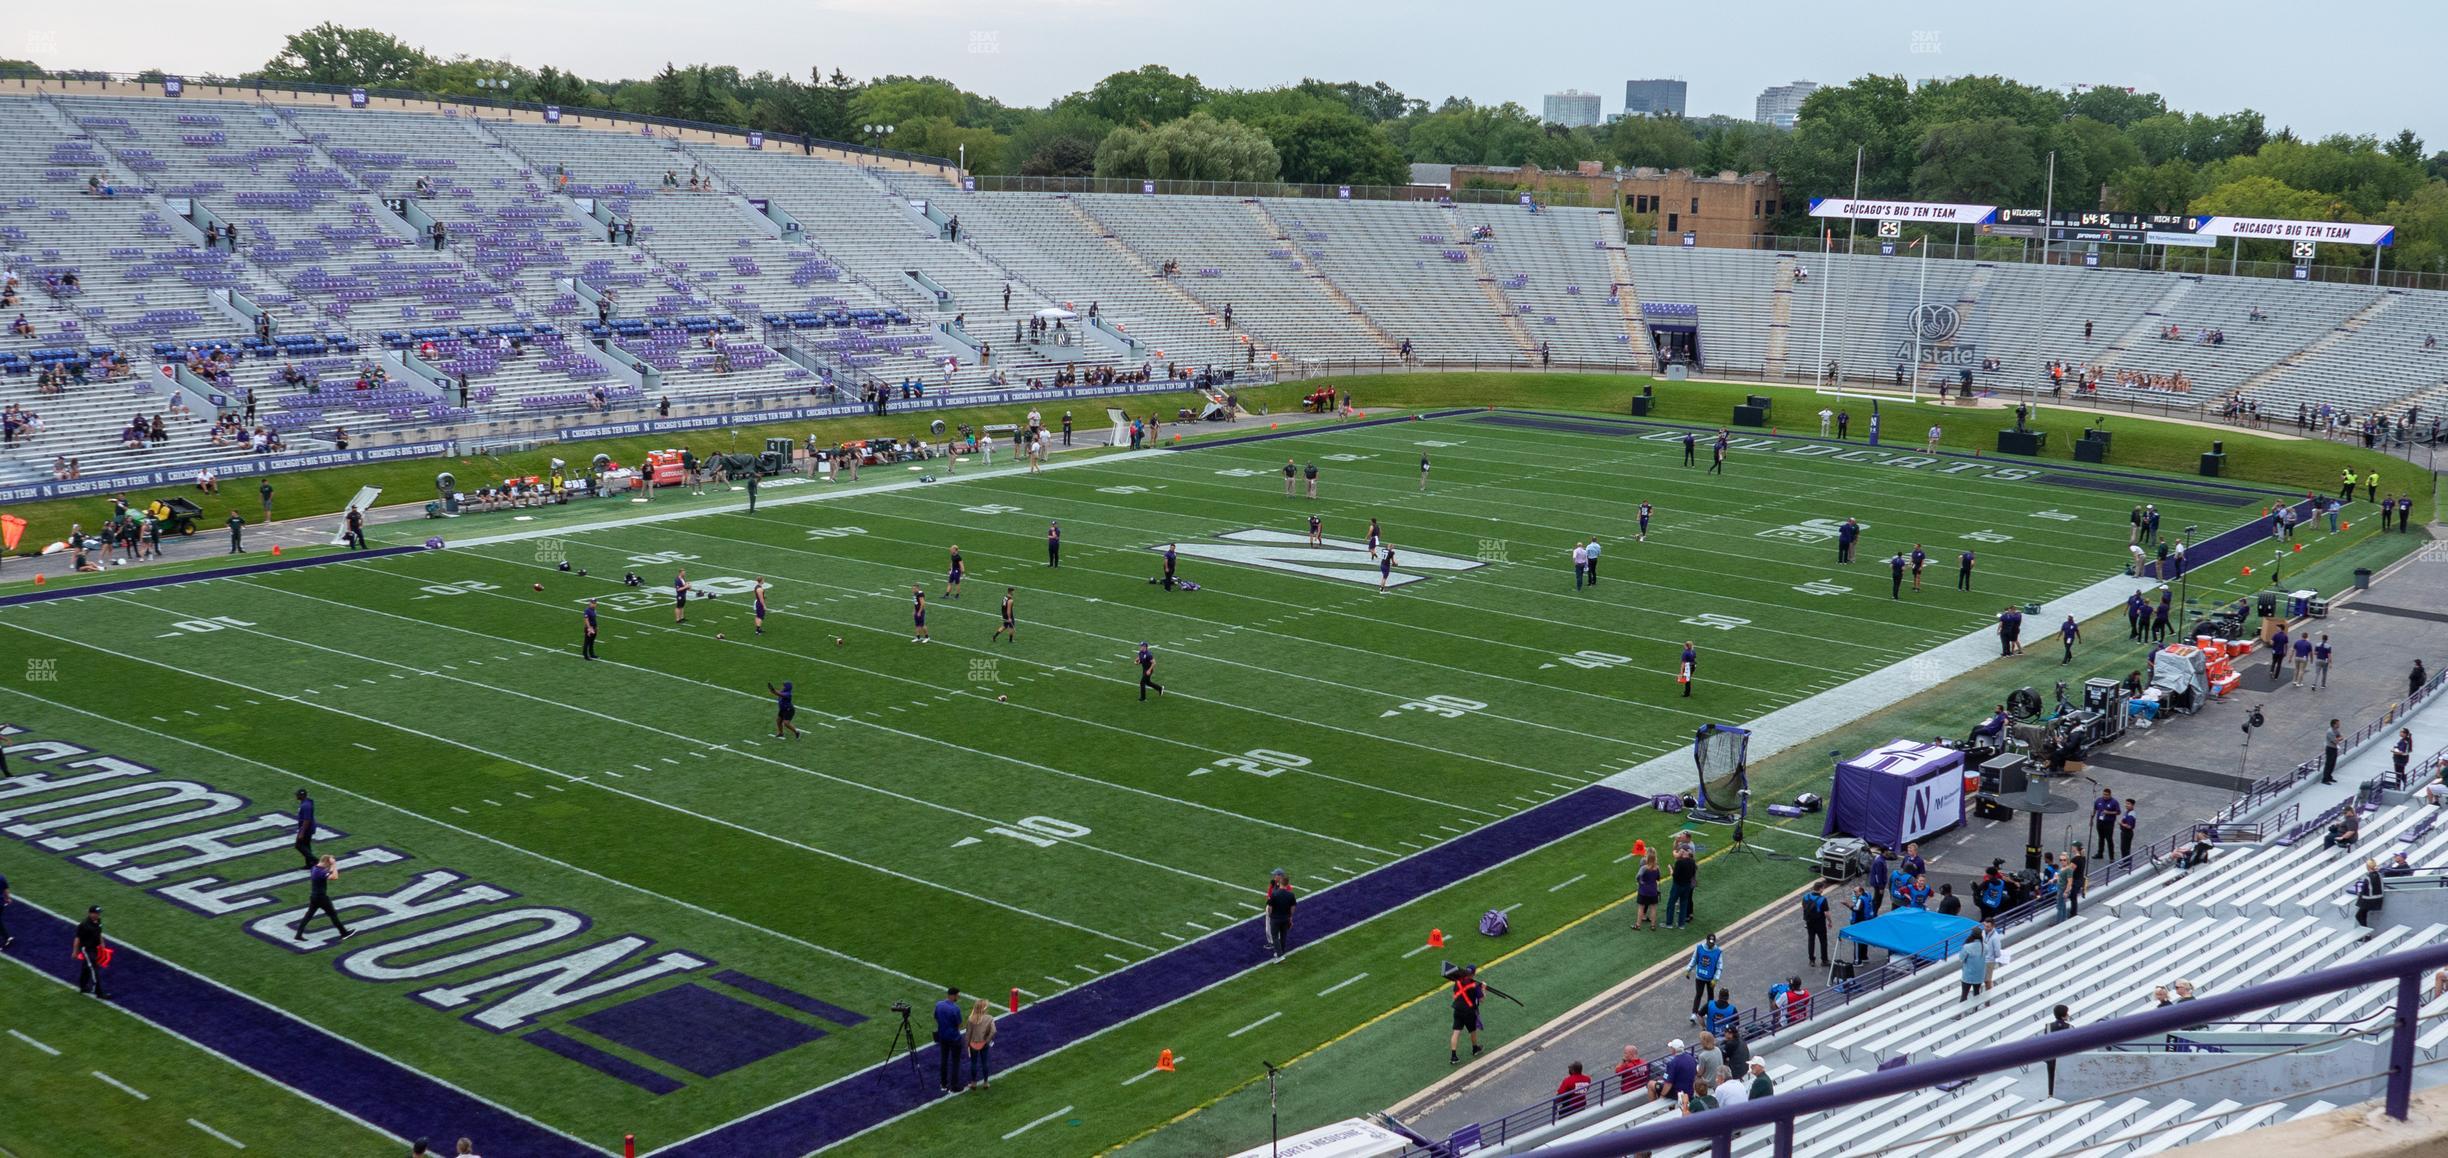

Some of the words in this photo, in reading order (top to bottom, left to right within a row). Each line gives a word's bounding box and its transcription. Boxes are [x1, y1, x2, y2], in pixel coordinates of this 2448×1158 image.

[548, 111, 558, 120] 110
[752, 137, 761, 145] 111
[1340, 190, 1349, 198] 114
[1843, 204, 1891, 216] CHICAGO'S
[1894, 206, 1909, 217] BIG
[1913, 207, 1929, 217] TEN
[1933, 208, 1956, 218] TEAM
[2003, 210, 2011, 221] 0
[2012, 209, 2041, 217] WILDCATS
[2171, 216, 2181, 224] ST
[2188, 218, 2197, 230] 0
[1881, 222, 1898, 235] 25
[2232, 222, 2282, 235] CHICAGO'S
[2285, 226, 2301, 236] BIG
[2305, 227, 2322, 237] TEN
[2326, 228, 2351, 239] TEAM
[1882, 246, 1893, 254] 117
[2295, 243, 2313, 256] 25
[1058, 334, 1065, 345] N
[1896, 341, 1973, 364] Allstate
[561, 430, 568, 439] N
[572, 427, 601, 438] CHICAGO'S
[602, 426, 612, 435] BIG
[612, 425, 624, 434] TEN
[624, 424, 640, 433] TEAM
[644, 422, 650, 431] N
[654, 419, 681, 430] CHICAGO'S
[682, 419, 691, 428] BIG
[692, 418, 703, 427] TEN
[703, 417, 718, 426] TEAM
[722, 416, 728, 425] N
[759, 413, 768, 421] BIG
[768, 412, 778, 420] TEN
[779, 411, 793, 420] TEAM
[797, 410, 803, 418] N
[806, 407, 832, 417] CHICAGO'S
[832, 406, 841, 415] BIG
[841, 405, 851, 414] TEN
[851, 405, 865, 413] TEAM
[901, 400, 910, 409] BIG
[911, 400, 920, 408] TEN
[920, 399, 934, 408] TEAM
[937, 398, 942, 406] N
[945, 396, 970, 405] CHICAGO'S
[1870, 417, 1877, 426] N
[15, 488, 37, 499] TEAM
[43, 485, 53, 497] N
[58, 481, 98, 494] CHICAGO'S
[98, 479, 111, 489] BIG
[112, 478, 128, 488] TEN
[128, 475, 150, 485] TEAM
[155, 472, 163, 483] N
[168, 469, 202, 481] CHICAGO'
[219, 466, 233, 475] TEN
[234, 463, 254, 473] TEAM
[259, 461, 266, 472] N
[271, 458, 306, 470] CHICAGO'S
[306, 456, 318, 466] BIG
[318, 454, 333, 464] TEN
[333, 452, 352, 462] TEAM
[356, 450, 364, 461] N
[368, 447, 401, 459] CHICAGO'S
[401, 446, 413, 455] BIG
[412, 445, 426, 454] TEN
[427, 443, 445, 453] TEAM
[806, 526, 869, 538] 40
[627, 551, 702, 564] 30
[420, 580, 502, 596] 20
[1792, 582, 1854, 596] 40
[170, 616, 258, 633] 10
[1679, 613, 1752, 631] 50
[1559, 650, 1633, 669] 40
[1400, 694, 1489, 719] 30
[1212, 748, 1313, 778] 20
[1910, 785, 1931, 834] N
[985, 815, 1092, 848] 10
[1309, 1129, 1362, 1147] MEDICINE
